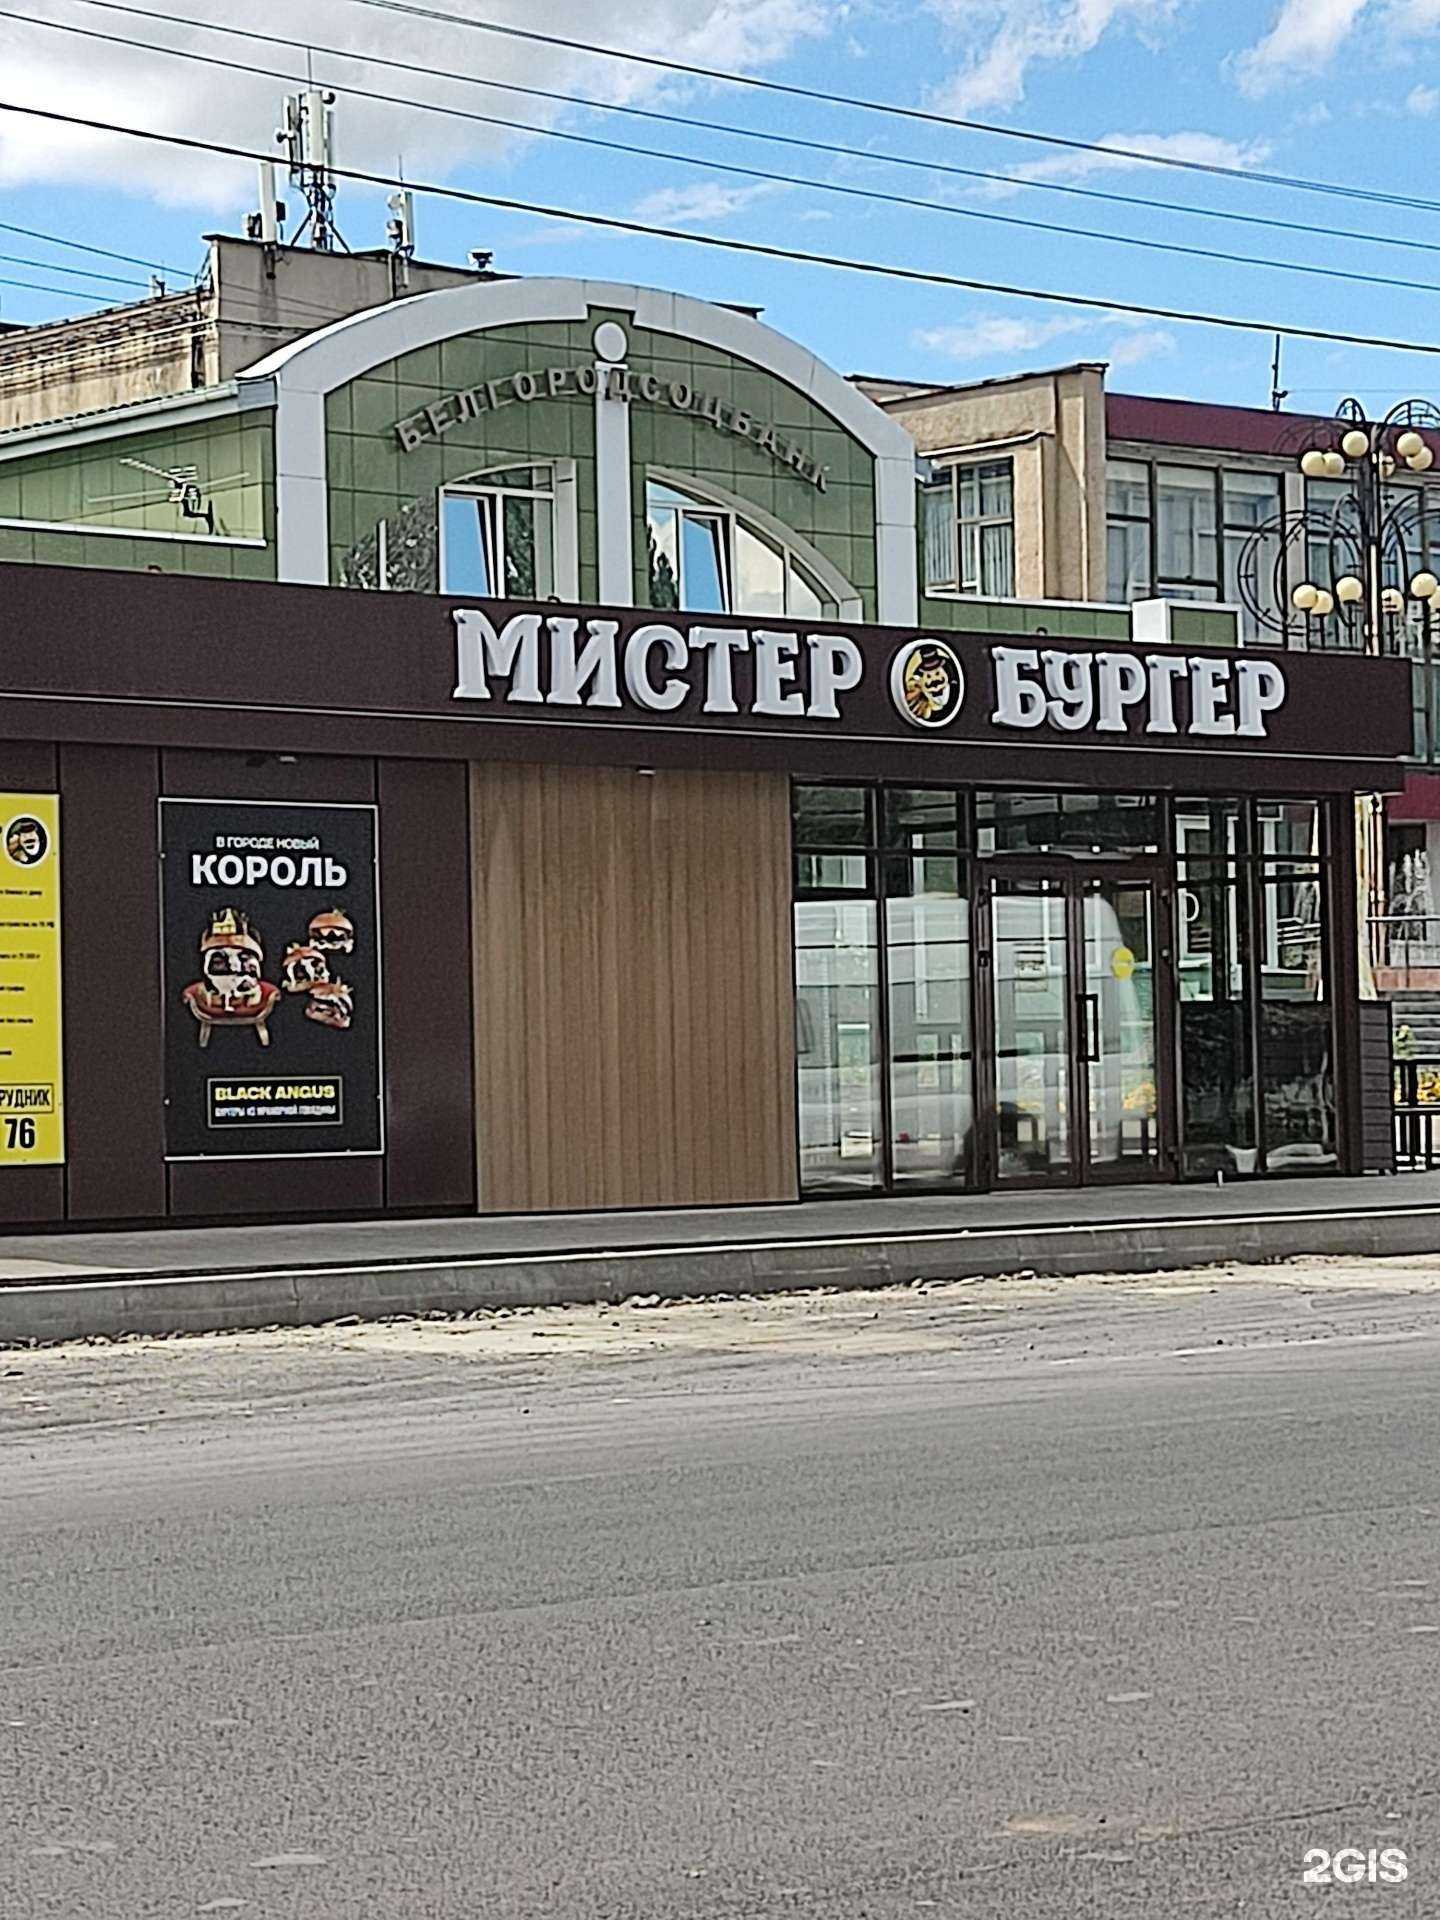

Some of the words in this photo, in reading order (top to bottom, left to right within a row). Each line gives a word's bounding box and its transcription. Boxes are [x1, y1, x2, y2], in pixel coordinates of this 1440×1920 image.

[452, 609, 863, 719] МИСТЕР
[991, 646, 1286, 737] БУРГЕР
[215, 836, 225, 849] В
[227, 836, 275, 849] ГОРОДЕ
[276, 836, 320, 850] НОВЫЙ
[192, 854, 347, 887] КОРОЛЬ
[215, 1086, 272, 1101] BLACK
[275, 1085, 336, 1099] ANGUS
[5, 1117, 35, 1149] 76
